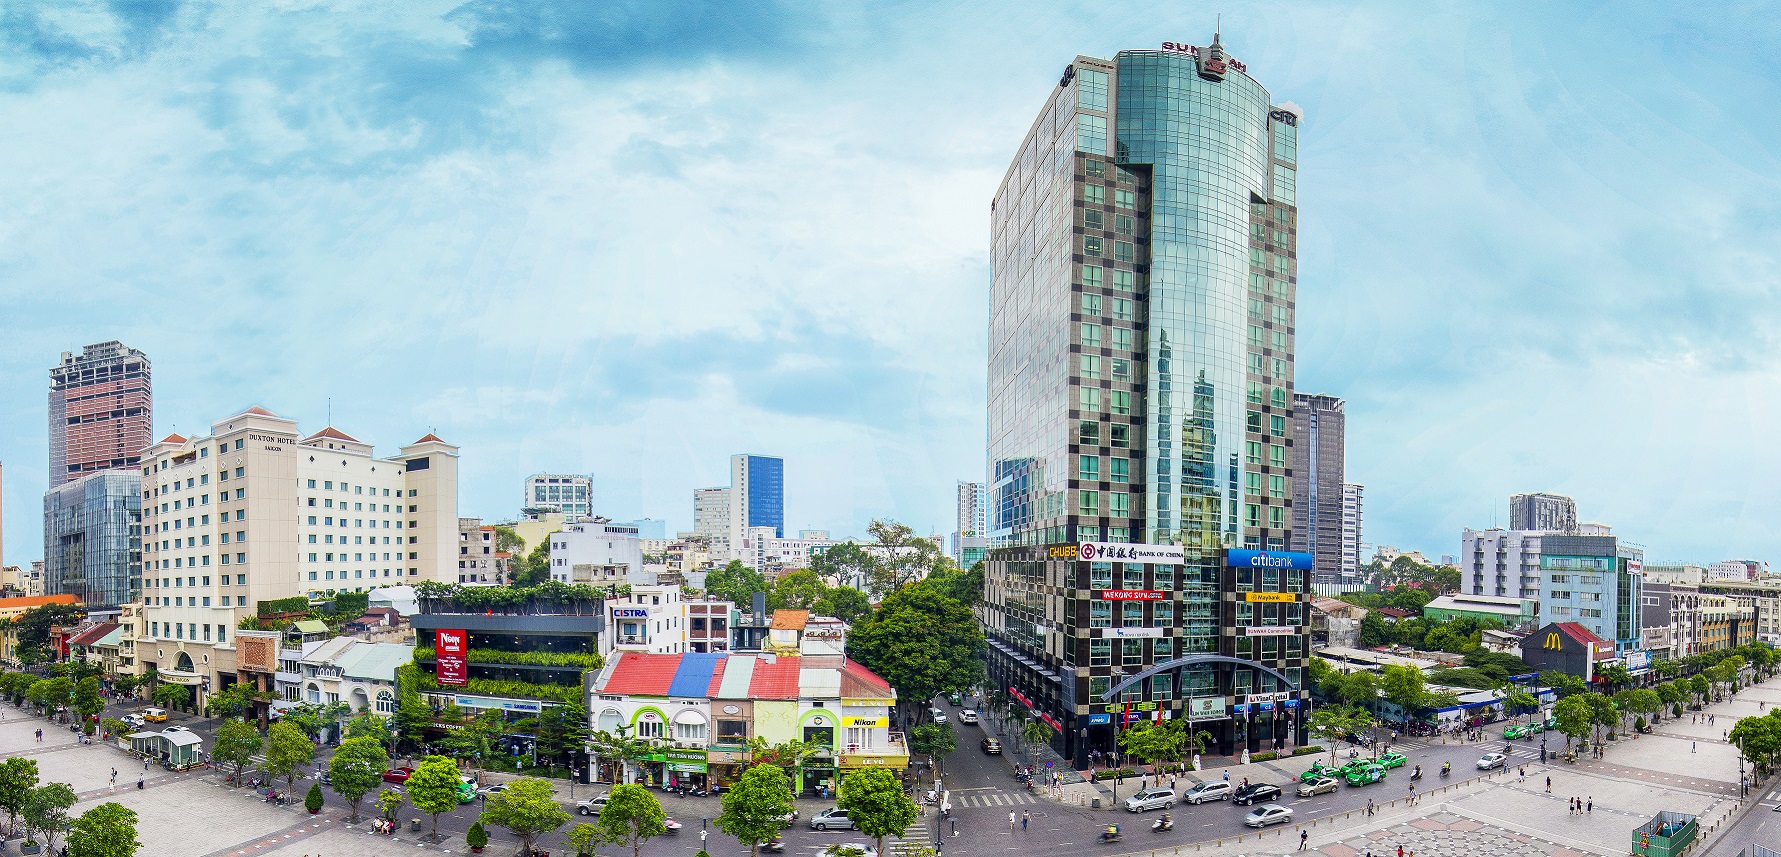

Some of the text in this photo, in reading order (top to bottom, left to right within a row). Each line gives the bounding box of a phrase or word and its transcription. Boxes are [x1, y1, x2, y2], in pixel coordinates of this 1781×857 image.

[249, 433, 296, 445] DUXTON HOTEL
[1049, 545, 1077, 557] CHUBB
[1251, 553, 1293, 568] citibank
[1103, 591, 1133, 599] MEKONG
[1255, 692, 1288, 702] VinaCpital
[513, 703, 538, 711] SAMSUNG
